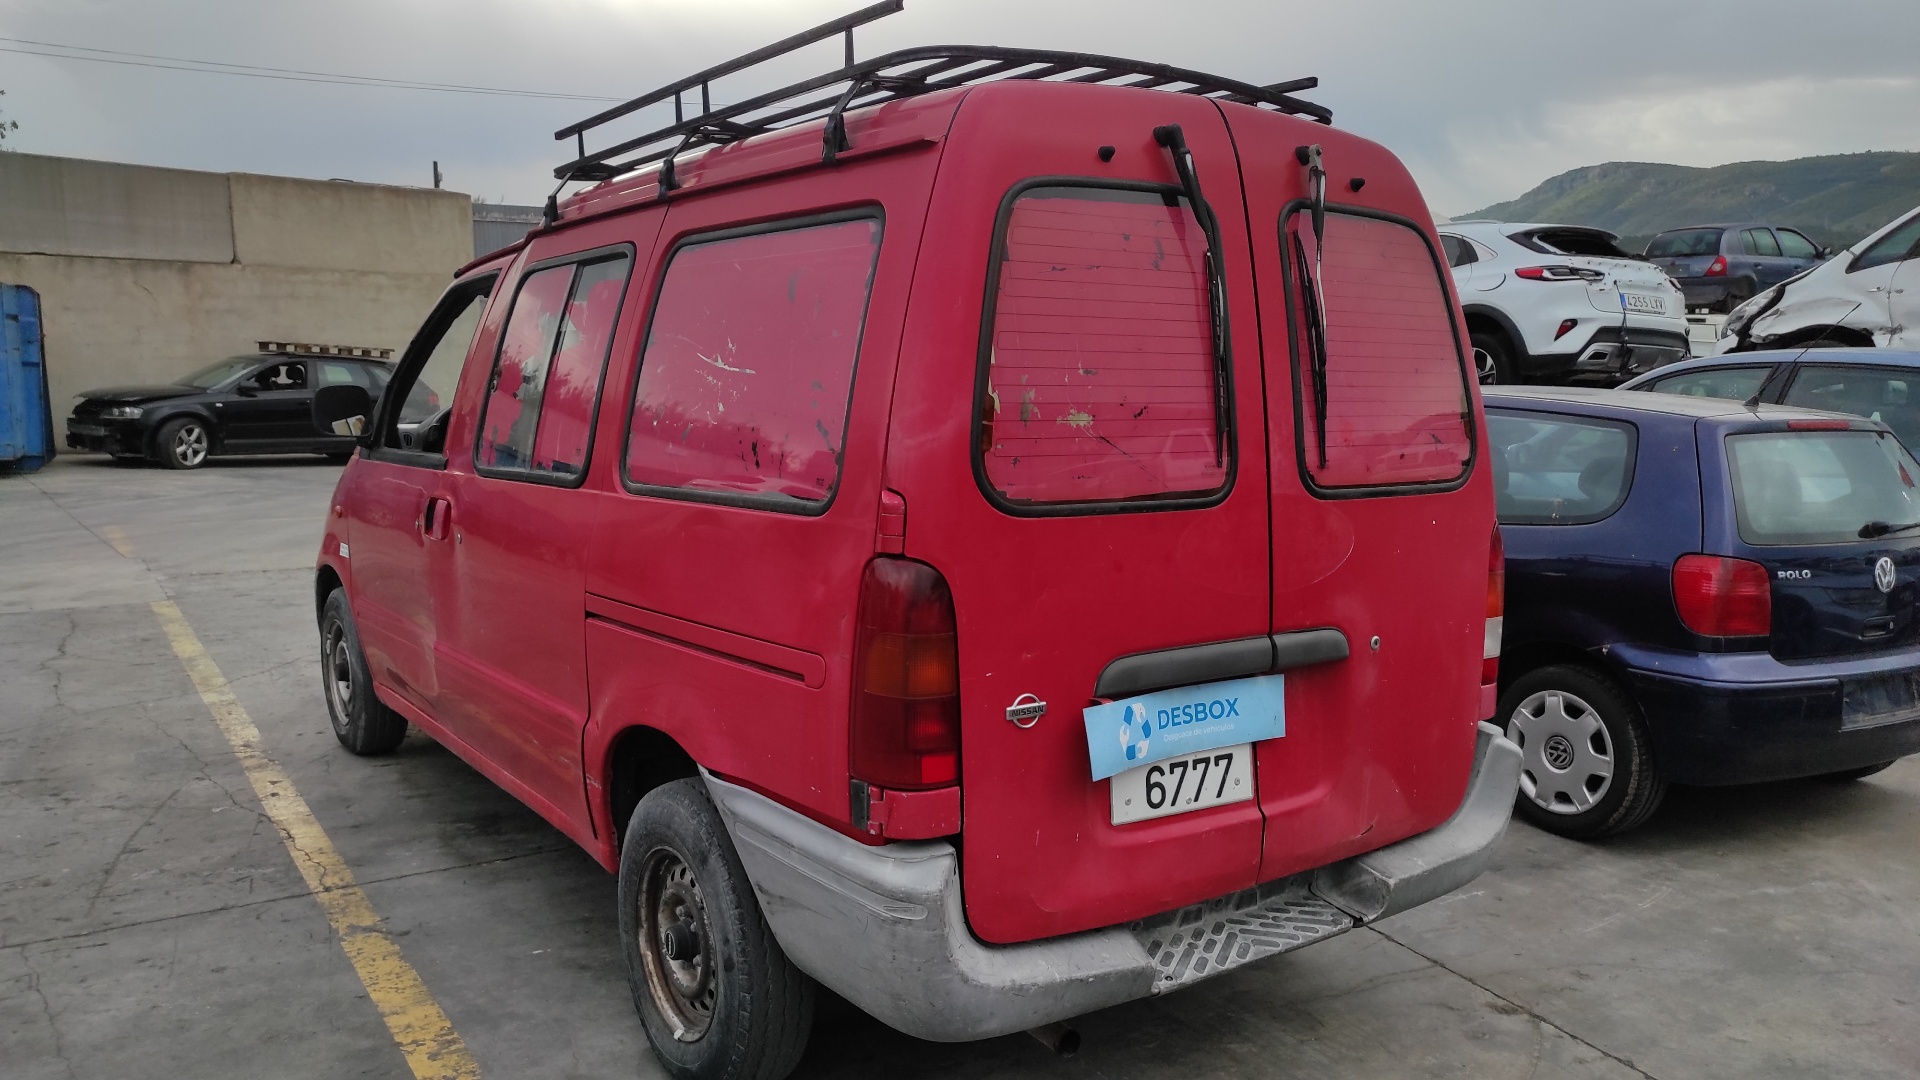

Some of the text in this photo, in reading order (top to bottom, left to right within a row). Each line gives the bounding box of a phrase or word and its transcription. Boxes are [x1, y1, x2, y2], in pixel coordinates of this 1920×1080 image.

[1627, 296, 1648, 307] 4255
[1777, 569, 1812, 580] POLO
[1011, 705, 1044, 718] NISSAN
[1157, 697, 1240, 731] DESBOX
[1163, 731, 1193, 742] Desguace
[1145, 753, 1234, 810] 6777
